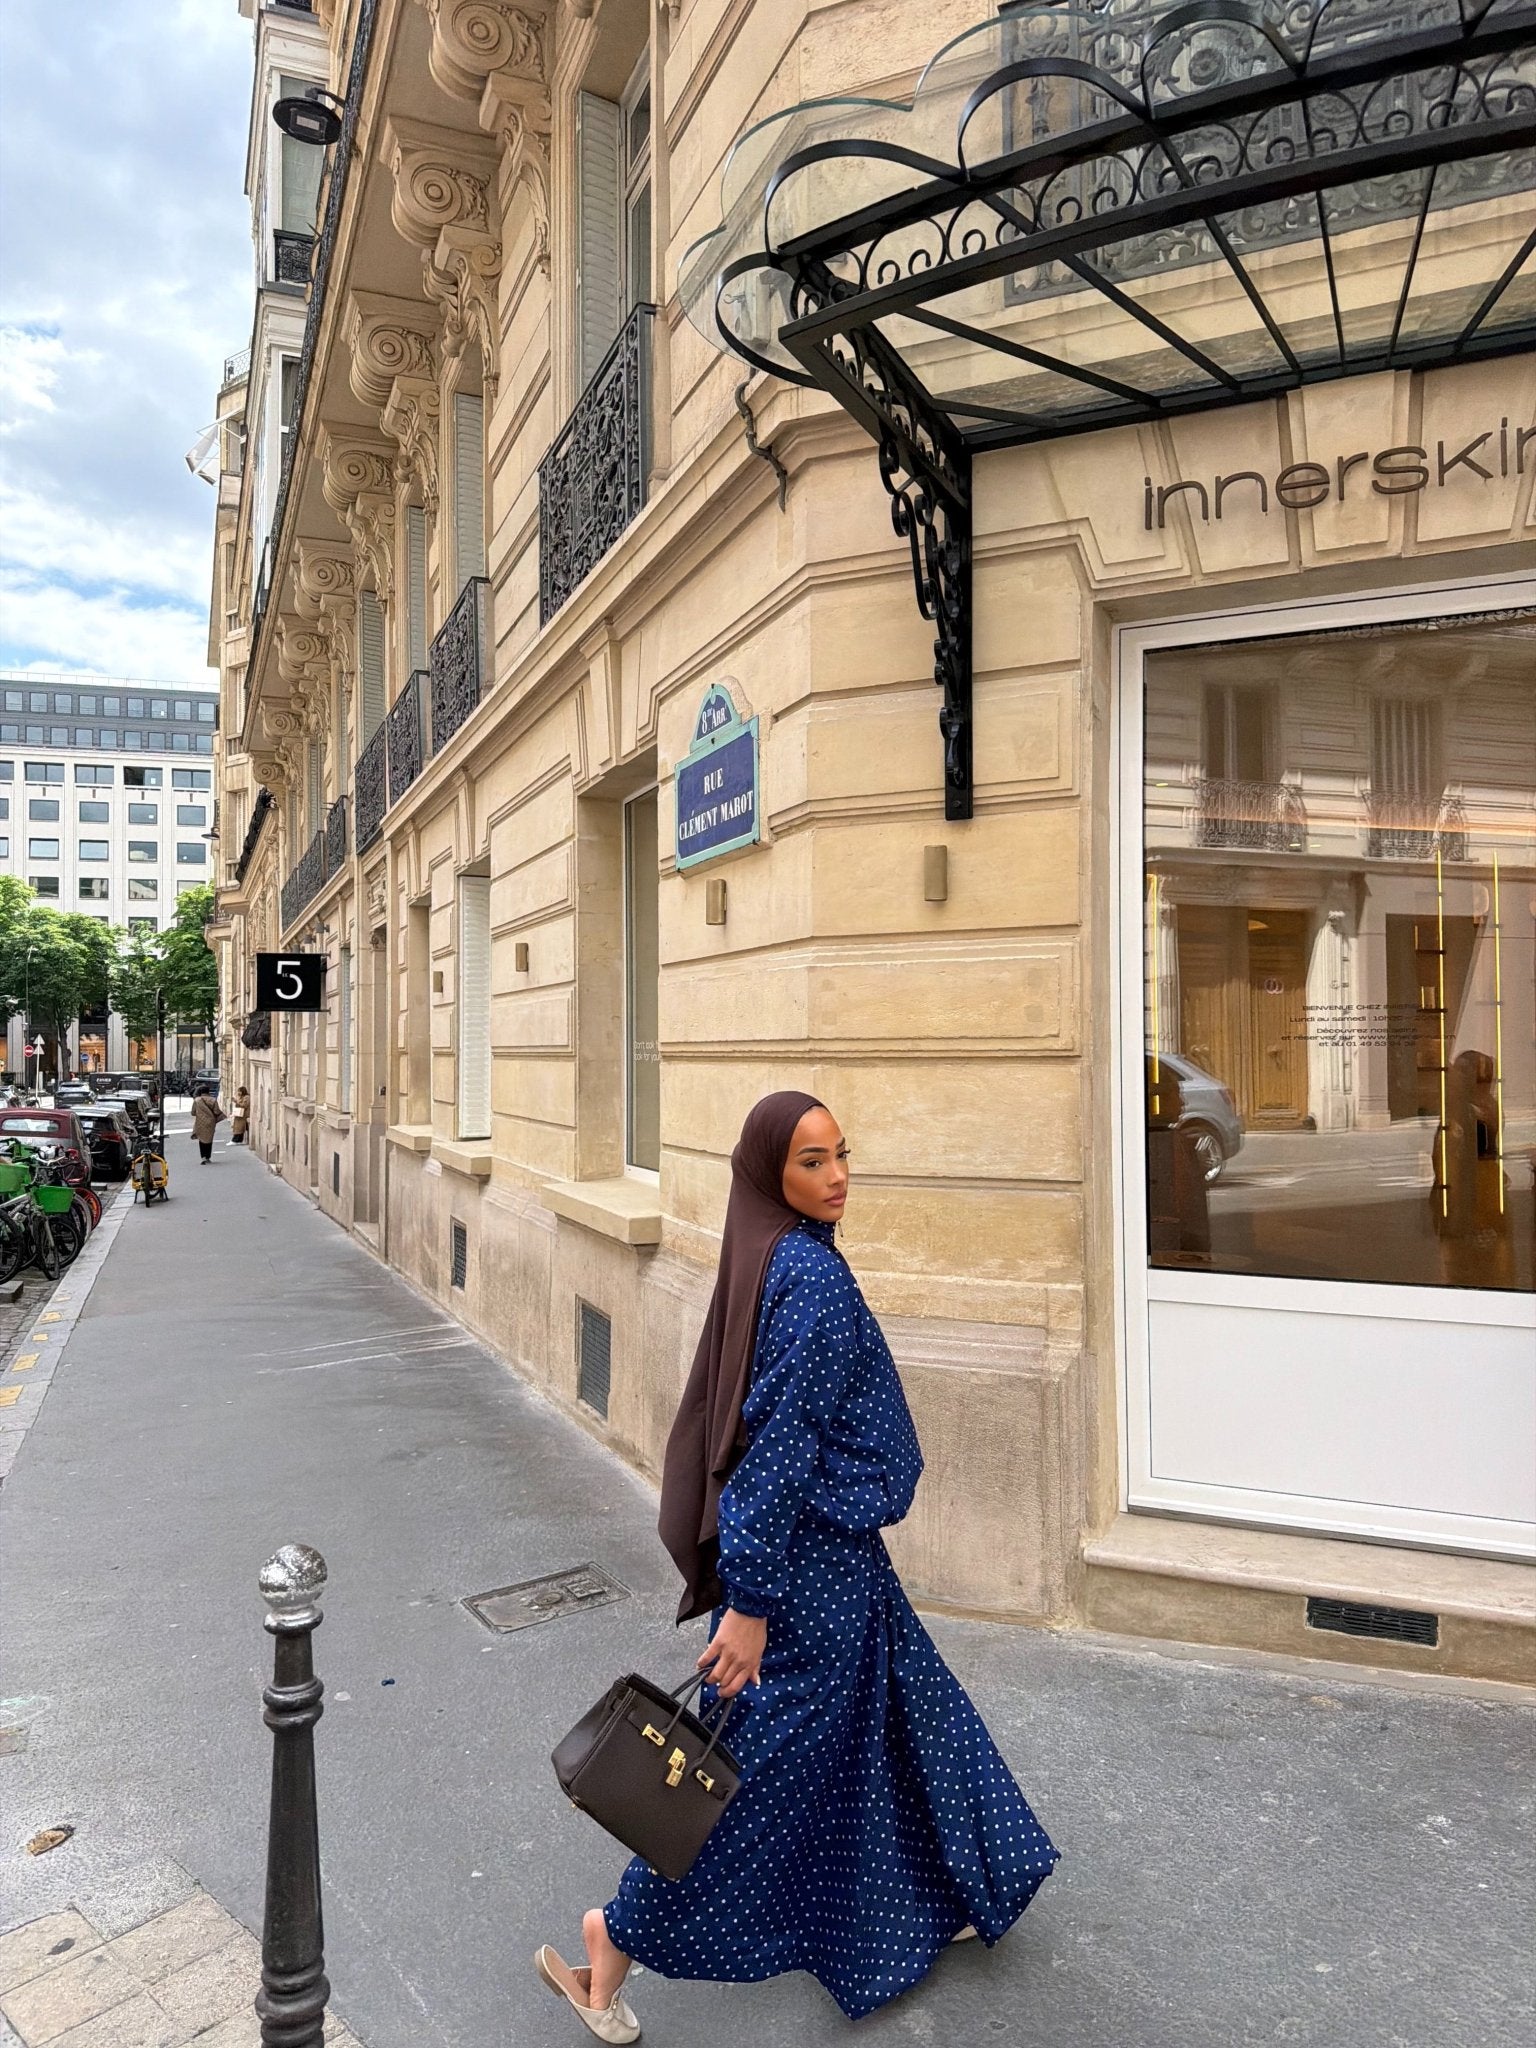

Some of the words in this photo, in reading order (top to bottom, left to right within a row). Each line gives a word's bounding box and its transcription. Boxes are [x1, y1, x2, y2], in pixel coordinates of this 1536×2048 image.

[703, 767, 724, 795] RUE
[679, 806, 718, 841] CLÉMENT
[720, 790, 754, 823] MAROT
[275, 960, 303, 1000] 5
